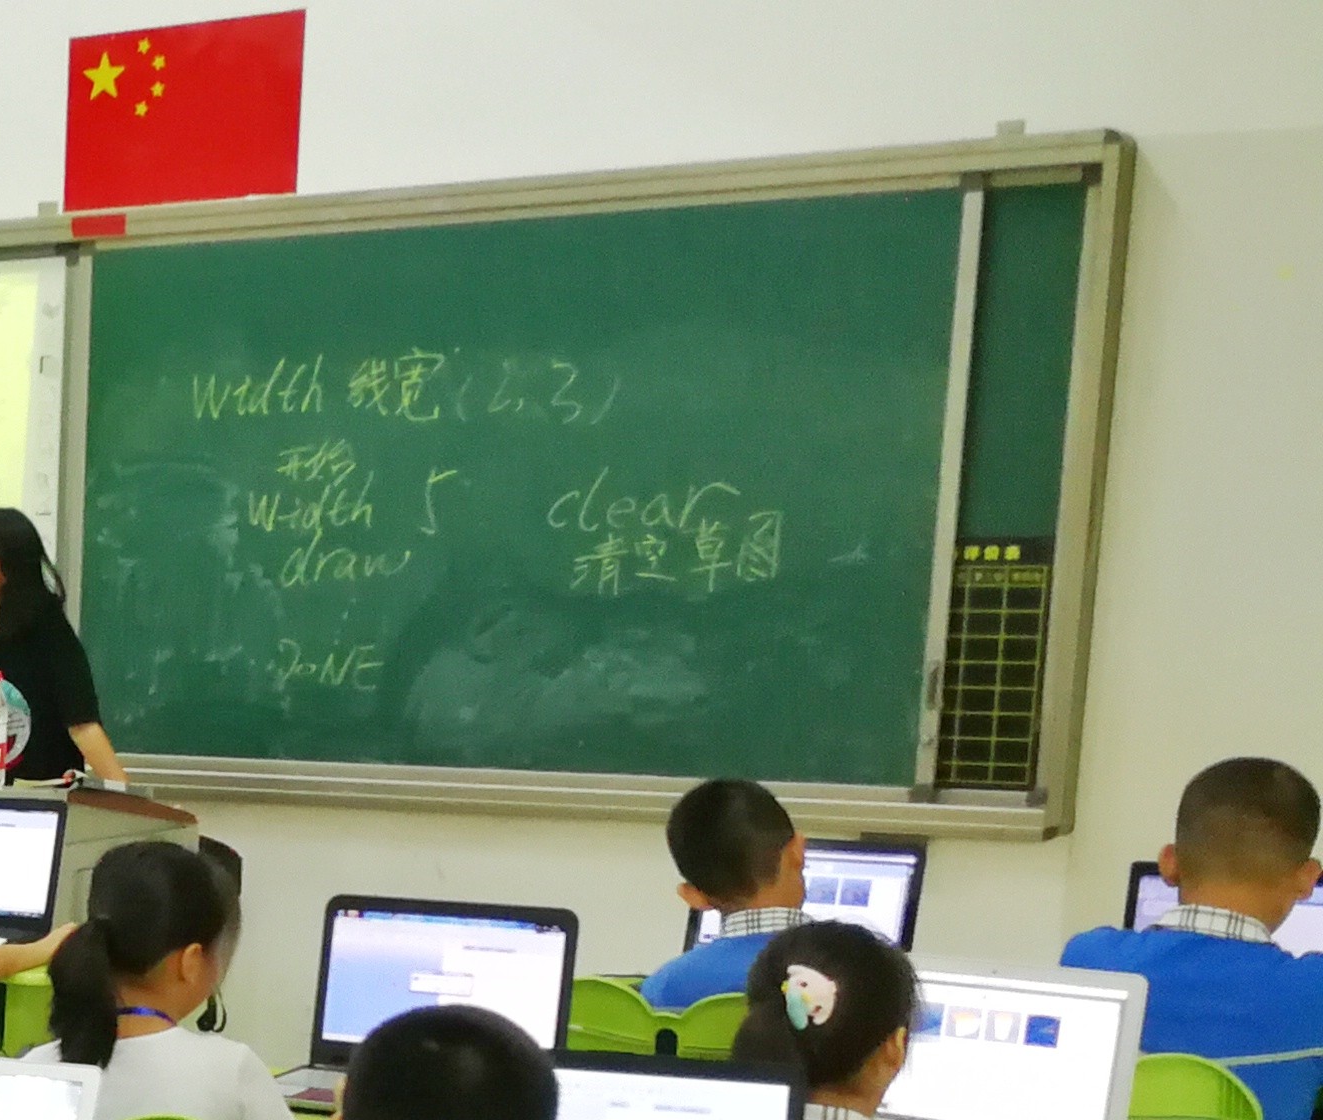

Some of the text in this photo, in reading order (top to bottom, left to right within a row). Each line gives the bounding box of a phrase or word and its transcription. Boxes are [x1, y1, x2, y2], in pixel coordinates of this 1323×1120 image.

[547, 465, 742, 533] clear
[279, 527, 412, 588] draw
[569, 509, 783, 596] 清空草图
